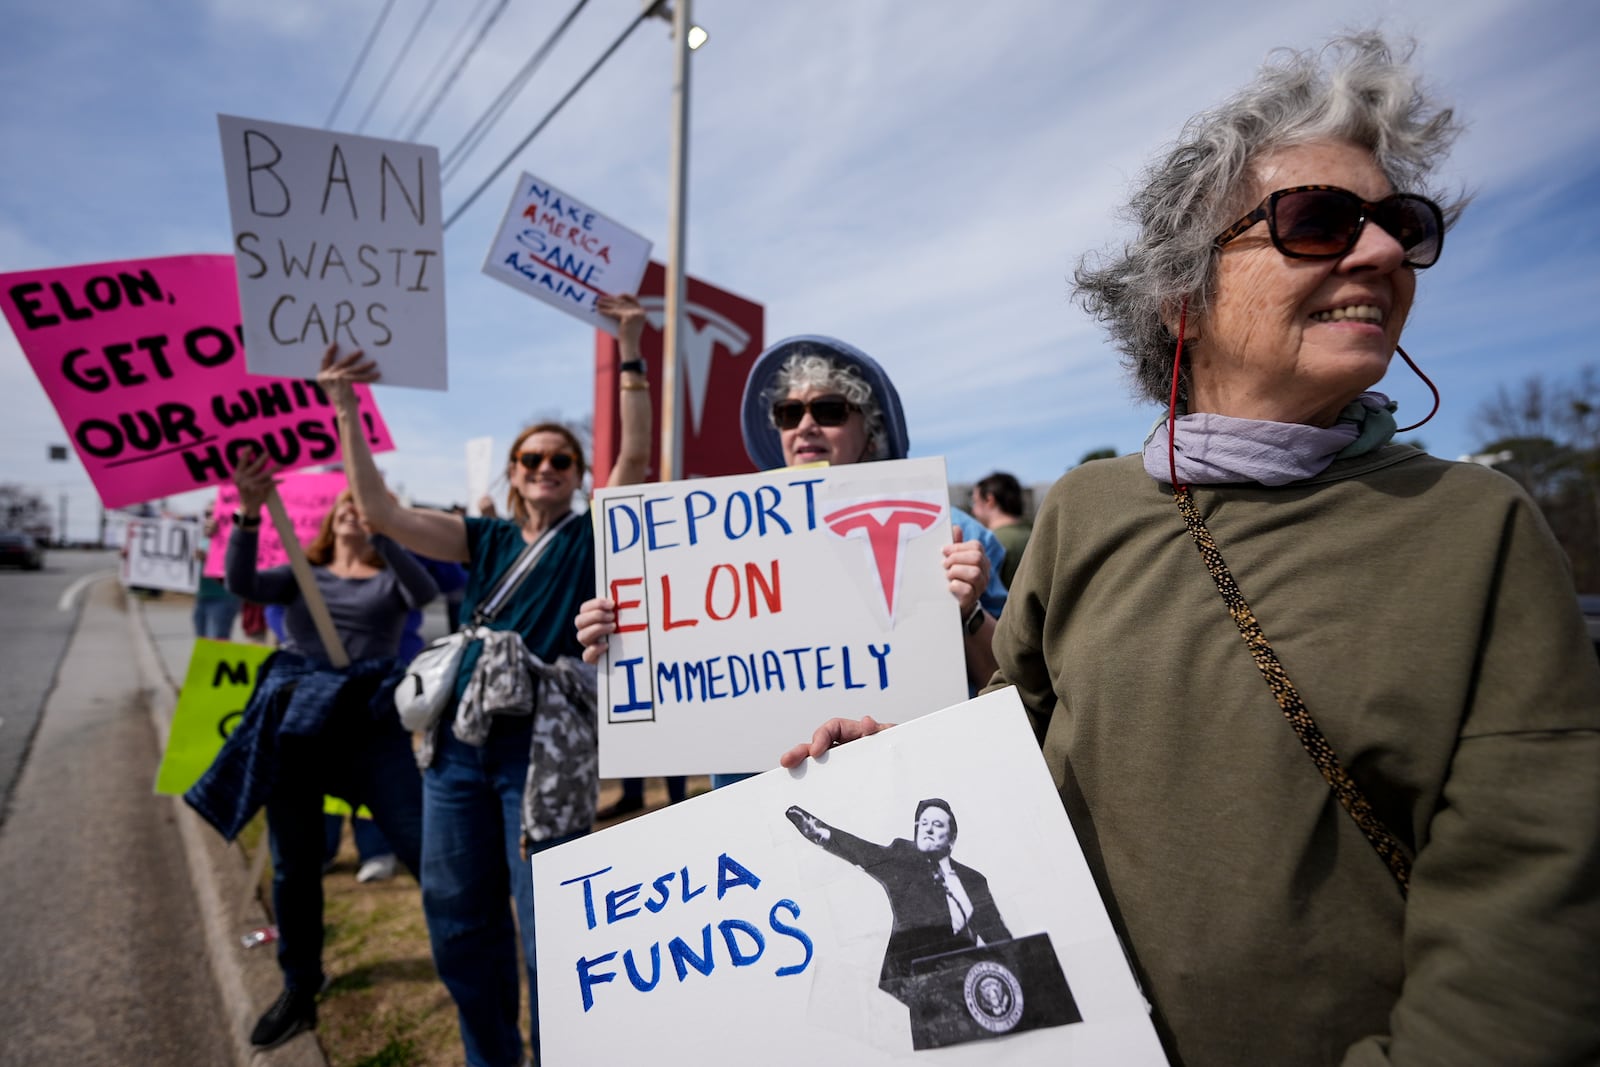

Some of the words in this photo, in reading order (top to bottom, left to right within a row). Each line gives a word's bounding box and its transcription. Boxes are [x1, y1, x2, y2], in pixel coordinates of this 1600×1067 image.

[244, 130, 425, 225] BAN
[529, 185, 595, 230] MAKE
[236, 232, 437, 292] SWASTI
[516, 229, 605, 286] SANE
[523, 204, 611, 264] AMERICA
[9, 270, 176, 330] ELON,
[269, 295, 393, 347] CARS
[61, 335, 174, 392] GET
[75, 402, 204, 459] OUR
[211, 378, 361, 428] WHIT
[182, 411, 380, 483] HOUS!
[607, 479, 825, 554] DEPORT
[610, 559, 782, 634] ELON
[612, 643, 891, 713] IMMEDIATELY
[559, 852, 762, 930] TESLA
[576, 898, 814, 1013] FUNDS
